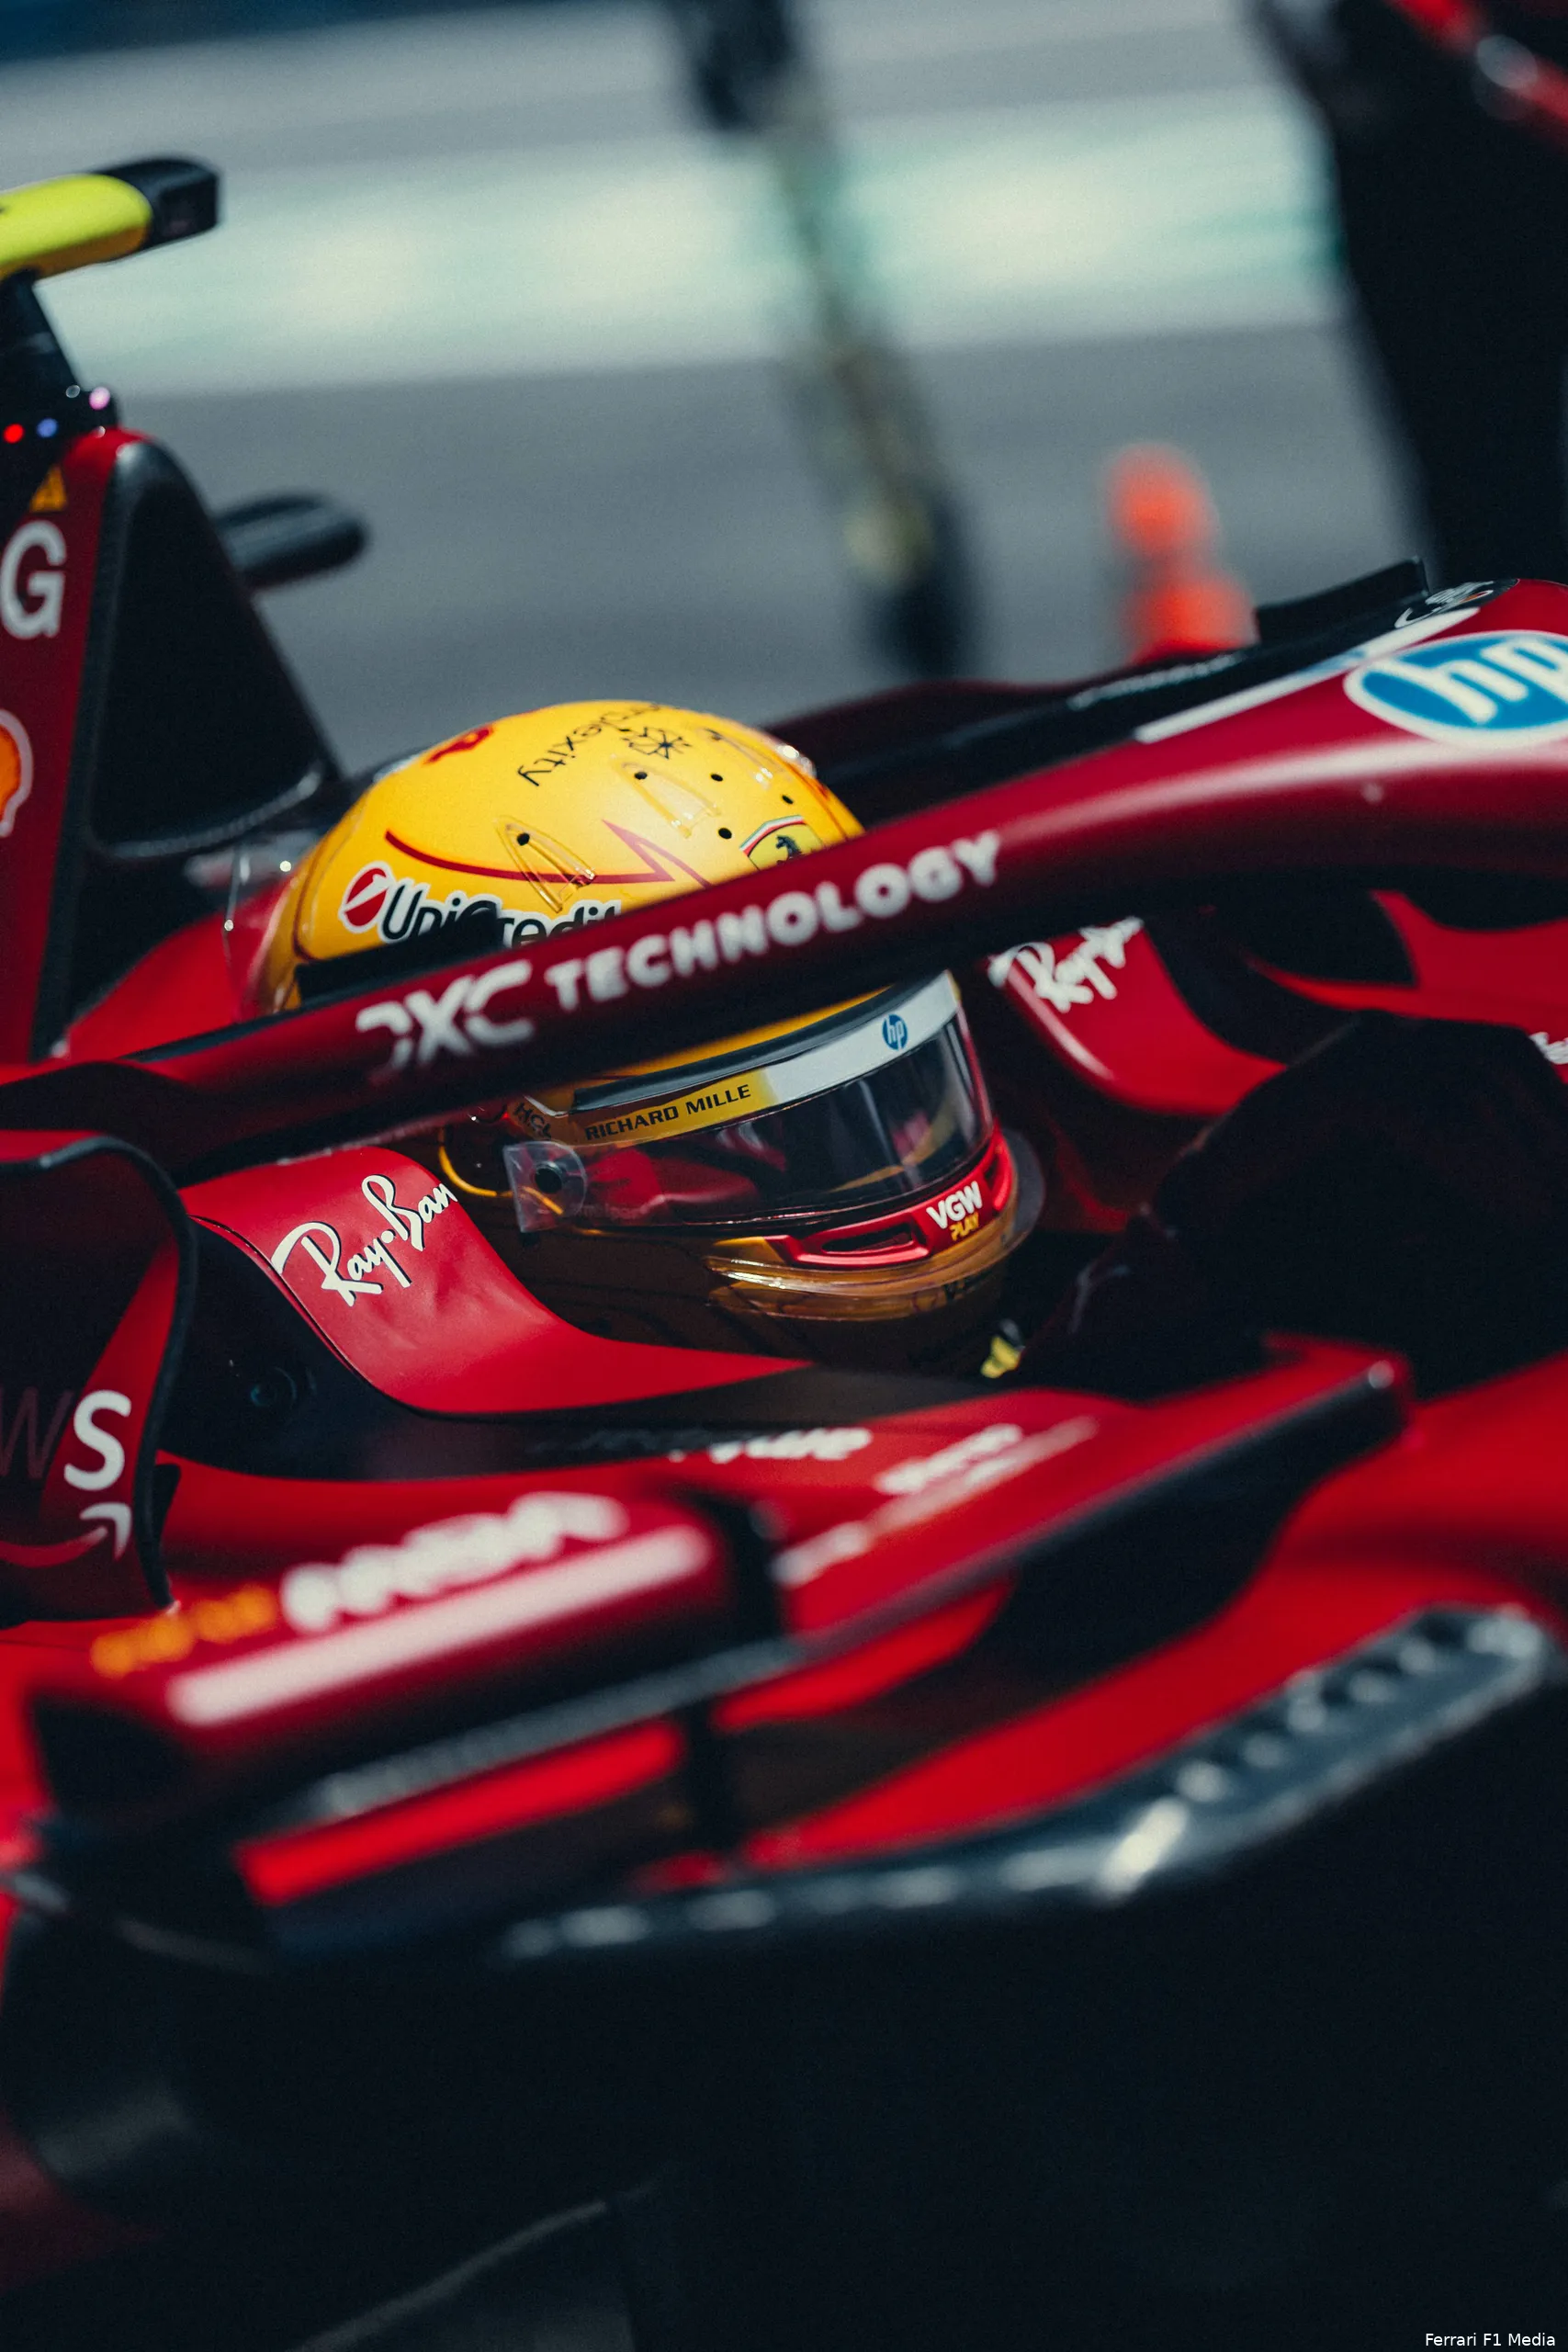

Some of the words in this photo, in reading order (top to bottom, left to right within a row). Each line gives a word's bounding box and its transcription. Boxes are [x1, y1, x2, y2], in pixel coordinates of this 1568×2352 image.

[1369, 636, 1568, 726] hp
[544, 831, 1000, 1011] TECHNOLOGY
[884, 1013, 906, 1050] hp
[585, 1105, 679, 1141] RICHARD
[685, 1084, 751, 1115] MILLE
[926, 1181, 983, 1229] VGW
